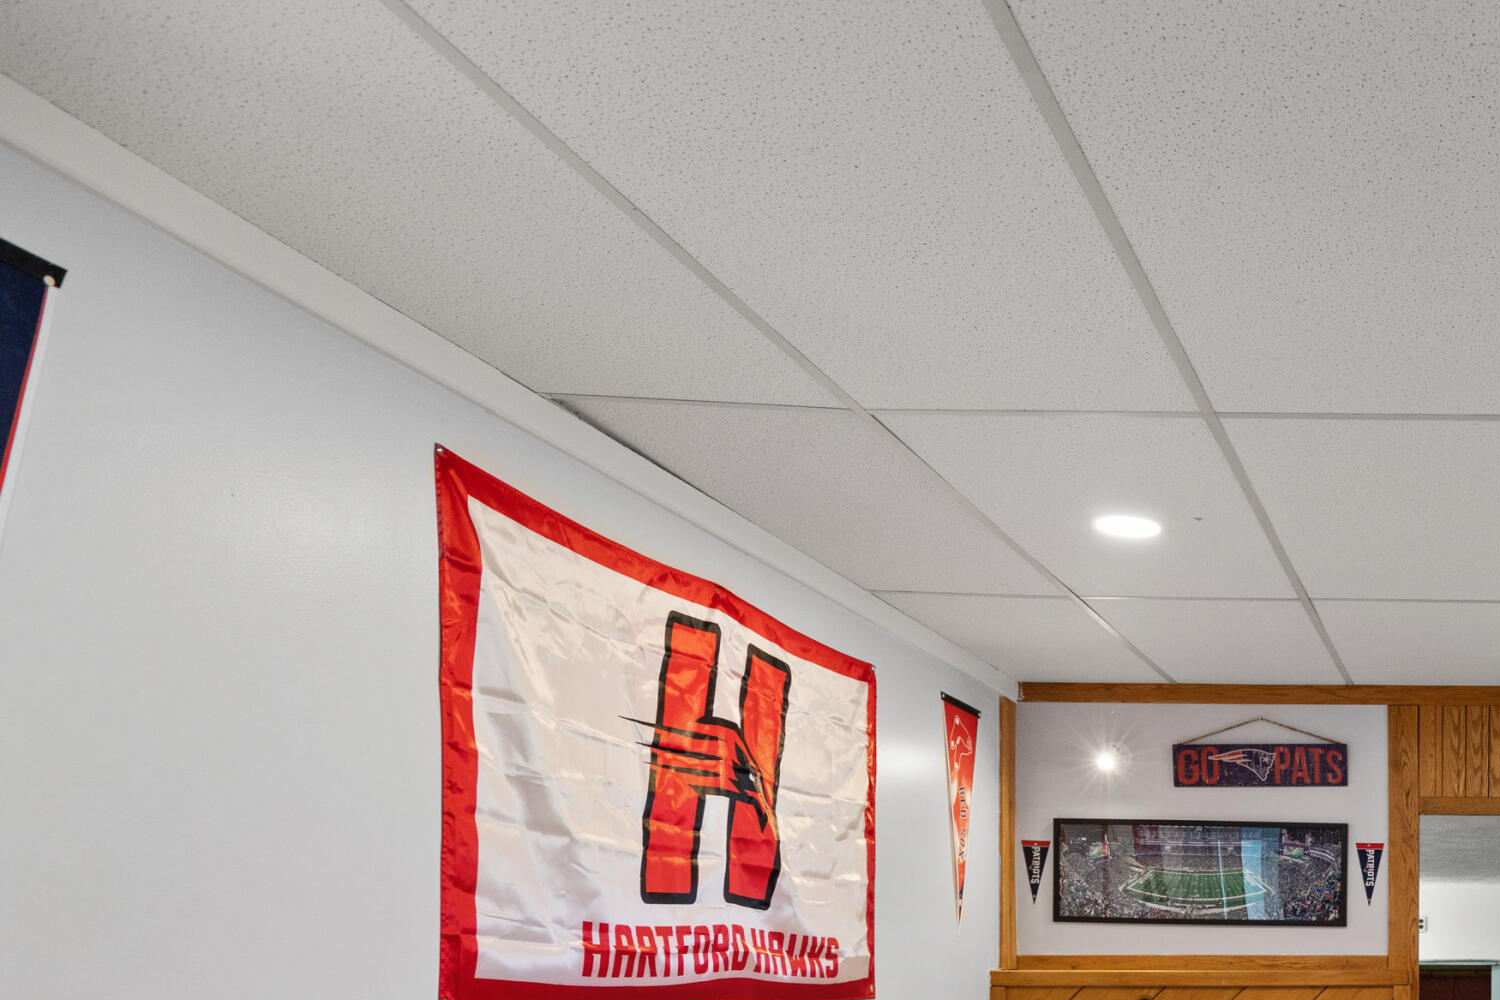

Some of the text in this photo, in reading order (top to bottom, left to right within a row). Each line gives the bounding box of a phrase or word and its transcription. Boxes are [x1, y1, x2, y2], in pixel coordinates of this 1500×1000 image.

[1177, 745, 1344, 785] GO PATS
[1030, 846, 1041, 884] PATRIOTS
[1365, 849, 1375, 887] PATRIOTS
[581, 921, 840, 979] HARTFORD HAWKS
